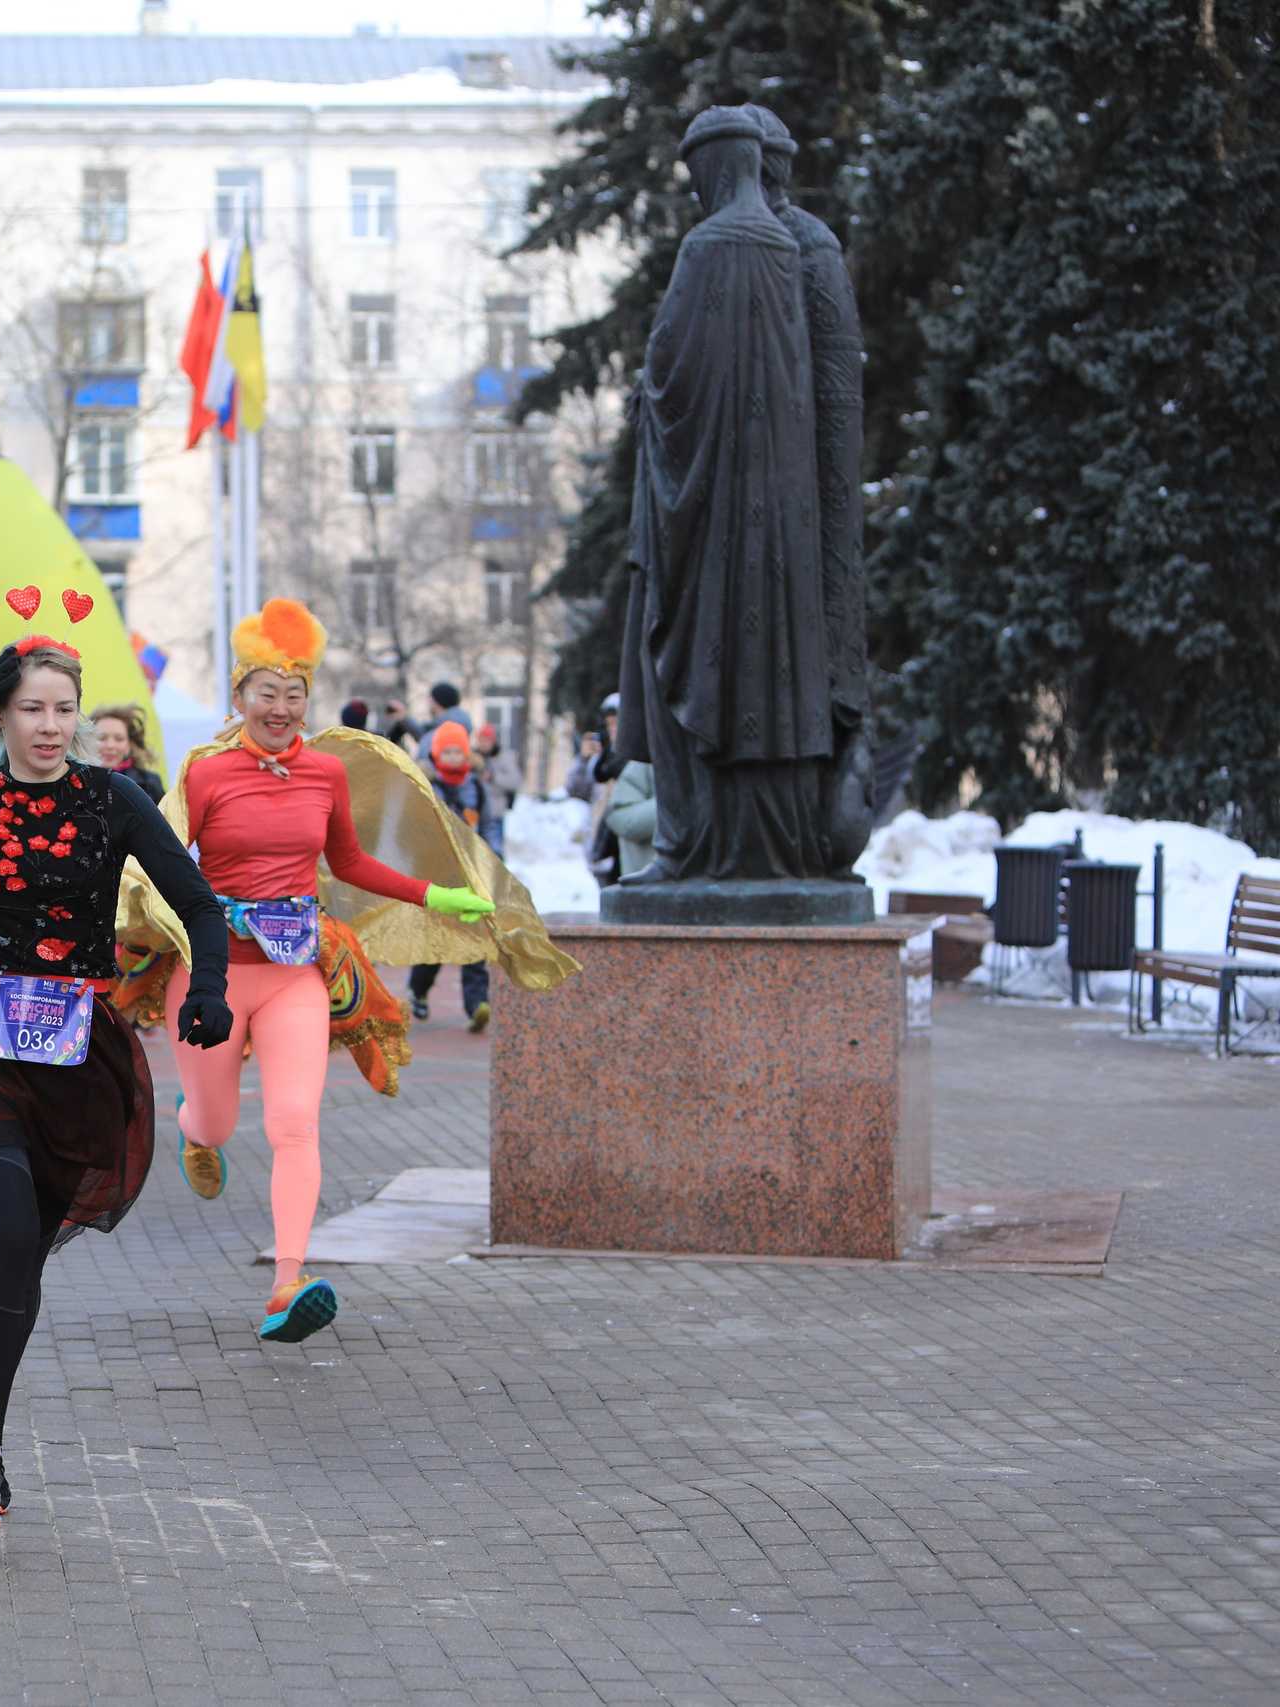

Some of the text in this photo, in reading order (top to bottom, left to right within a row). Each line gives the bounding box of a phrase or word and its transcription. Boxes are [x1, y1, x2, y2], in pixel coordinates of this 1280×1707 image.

[259, 919, 303, 929] ЖЕНСКИЙ
[283, 928, 301, 936] 2023
[269, 940, 292, 956] 013
[10, 993, 66, 1006] КОСТЮМИРОВАННЫЙ
[8, 1000, 66, 1018] ЖЕНСКИЙ
[8, 1010, 63, 1027] ЗАБЕГ 2023
[17, 1028, 56, 1052] 036
